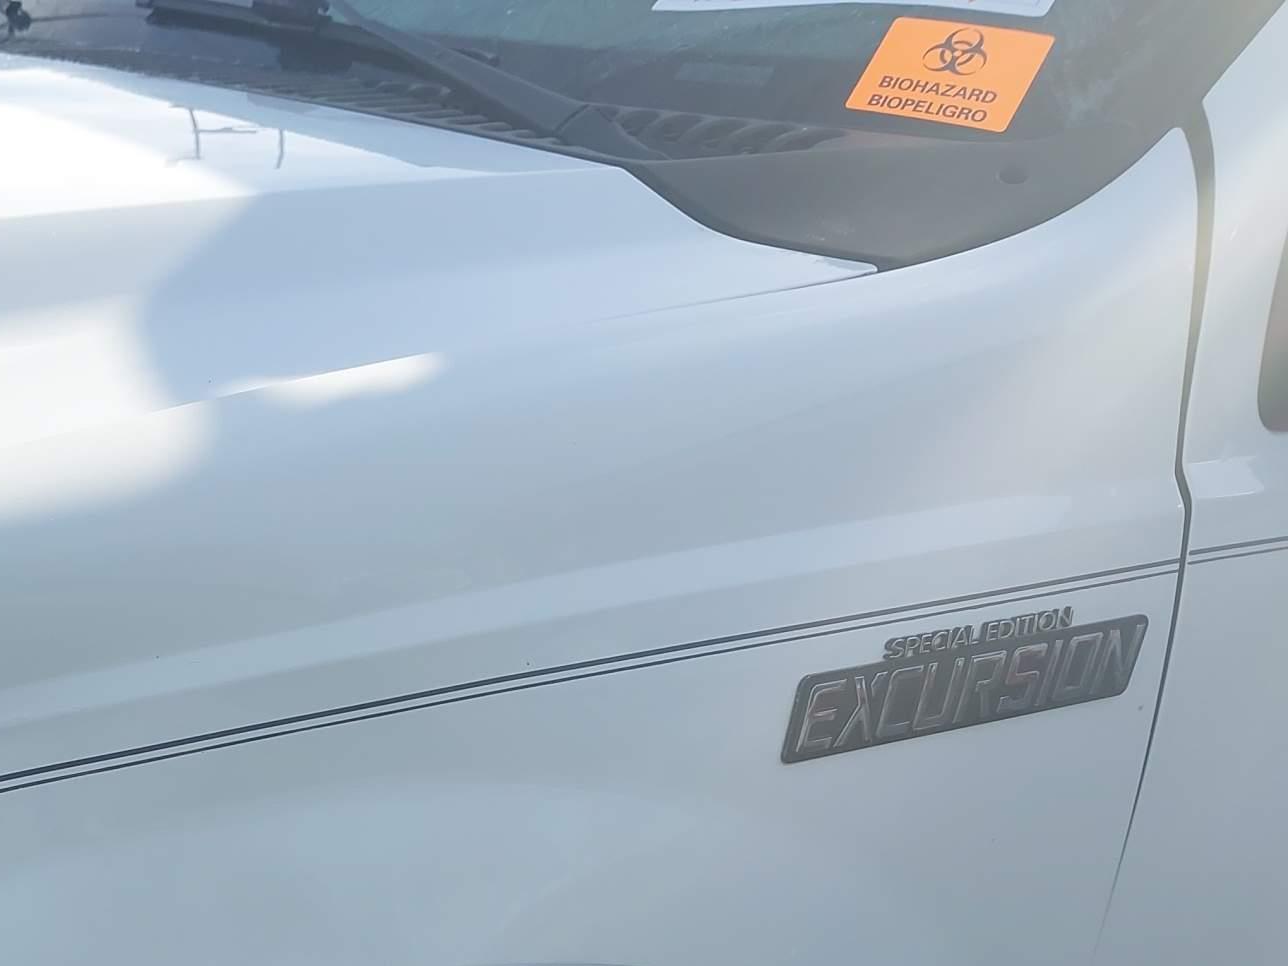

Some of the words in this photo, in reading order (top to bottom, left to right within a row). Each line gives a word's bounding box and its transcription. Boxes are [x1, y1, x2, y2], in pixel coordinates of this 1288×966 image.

[867, 94, 987, 122] BIOPELIGRO
[878, 75, 998, 104] BIOHAZARD
[883, 625, 980, 660] SPECIAL
[985, 606, 1074, 642] EDITION
[795, 623, 1145, 753] EXCURSION
